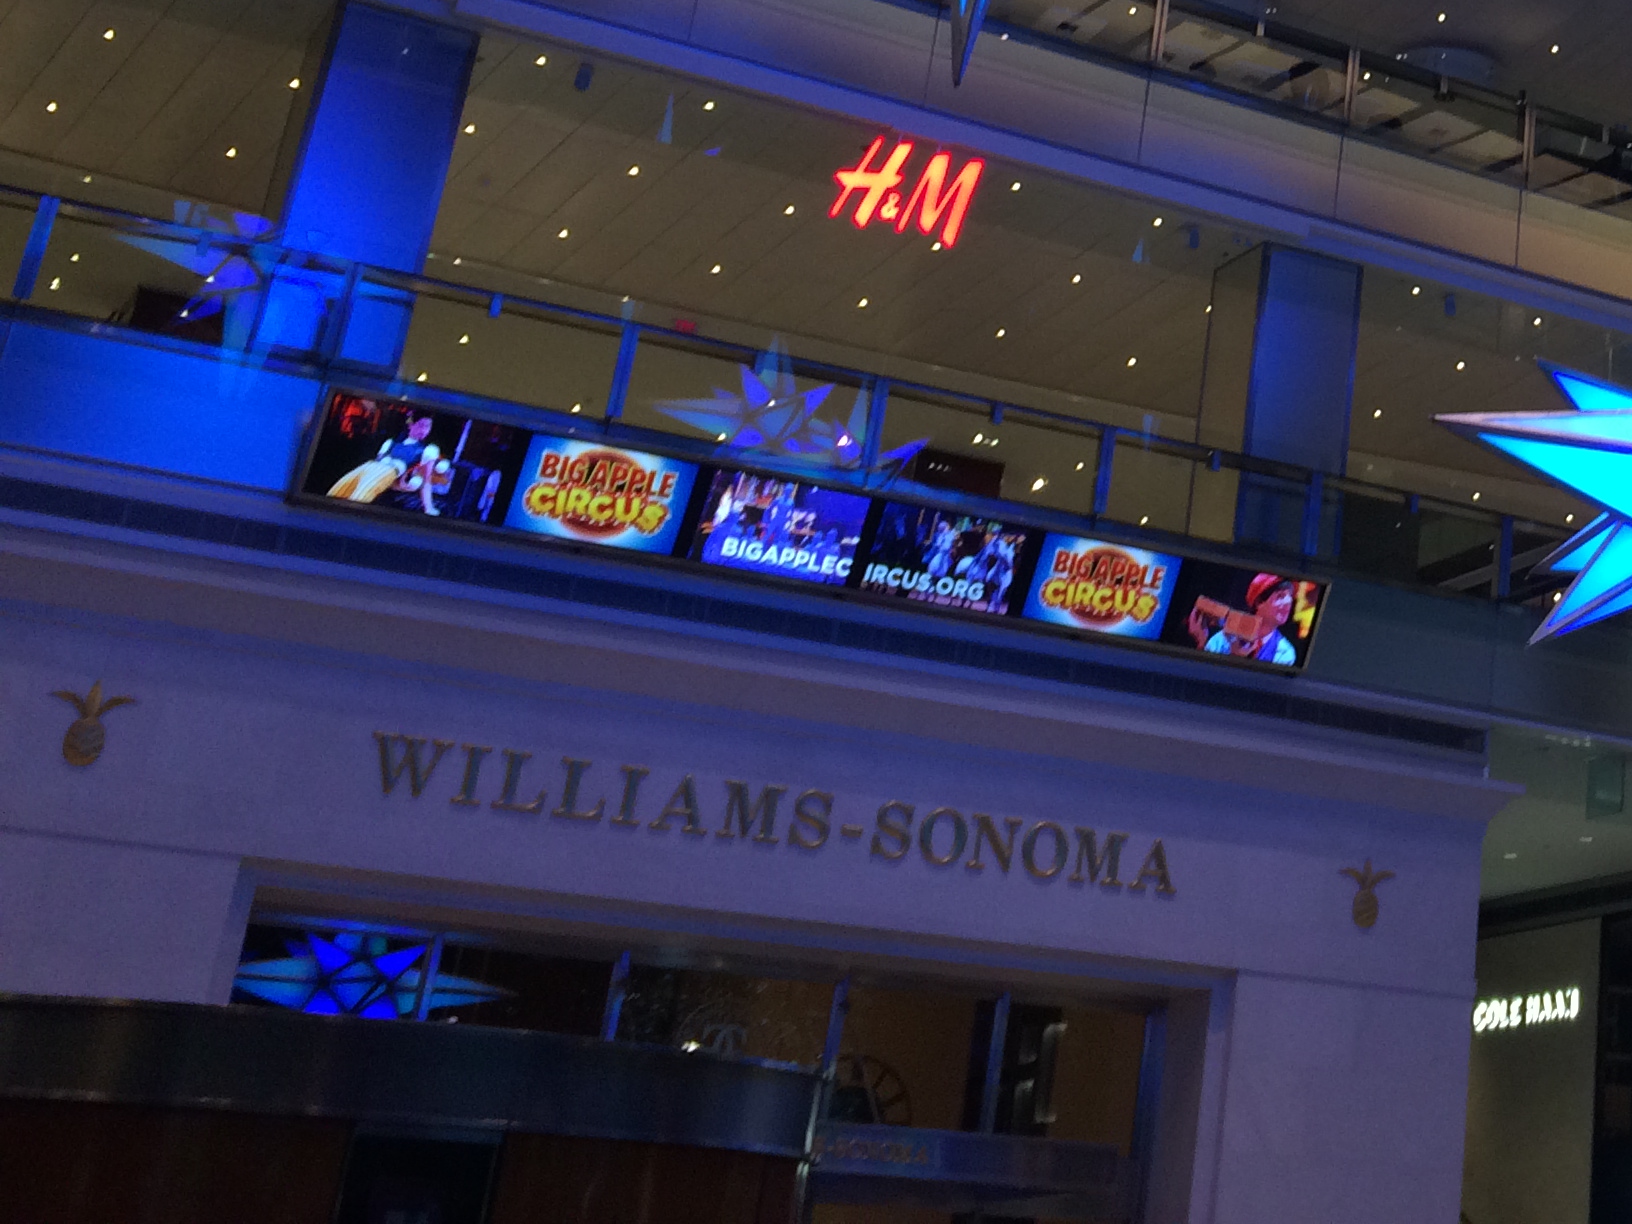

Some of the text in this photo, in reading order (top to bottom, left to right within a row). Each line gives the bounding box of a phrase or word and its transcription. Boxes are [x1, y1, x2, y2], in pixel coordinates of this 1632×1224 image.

[828, 135, 986, 249] H&M
[539, 452, 677, 498] BIG APPLE
[527, 482, 669, 534] CIRCUS
[720, 536, 853, 578] BIGAPPLEC
[1054, 550, 1165, 589] BIG APPLE
[1043, 579, 1158, 622] CIRCUS
[373, 731, 1178, 897] WILLIAMS-SONOMA
[1473, 996, 1523, 1033] COLE
